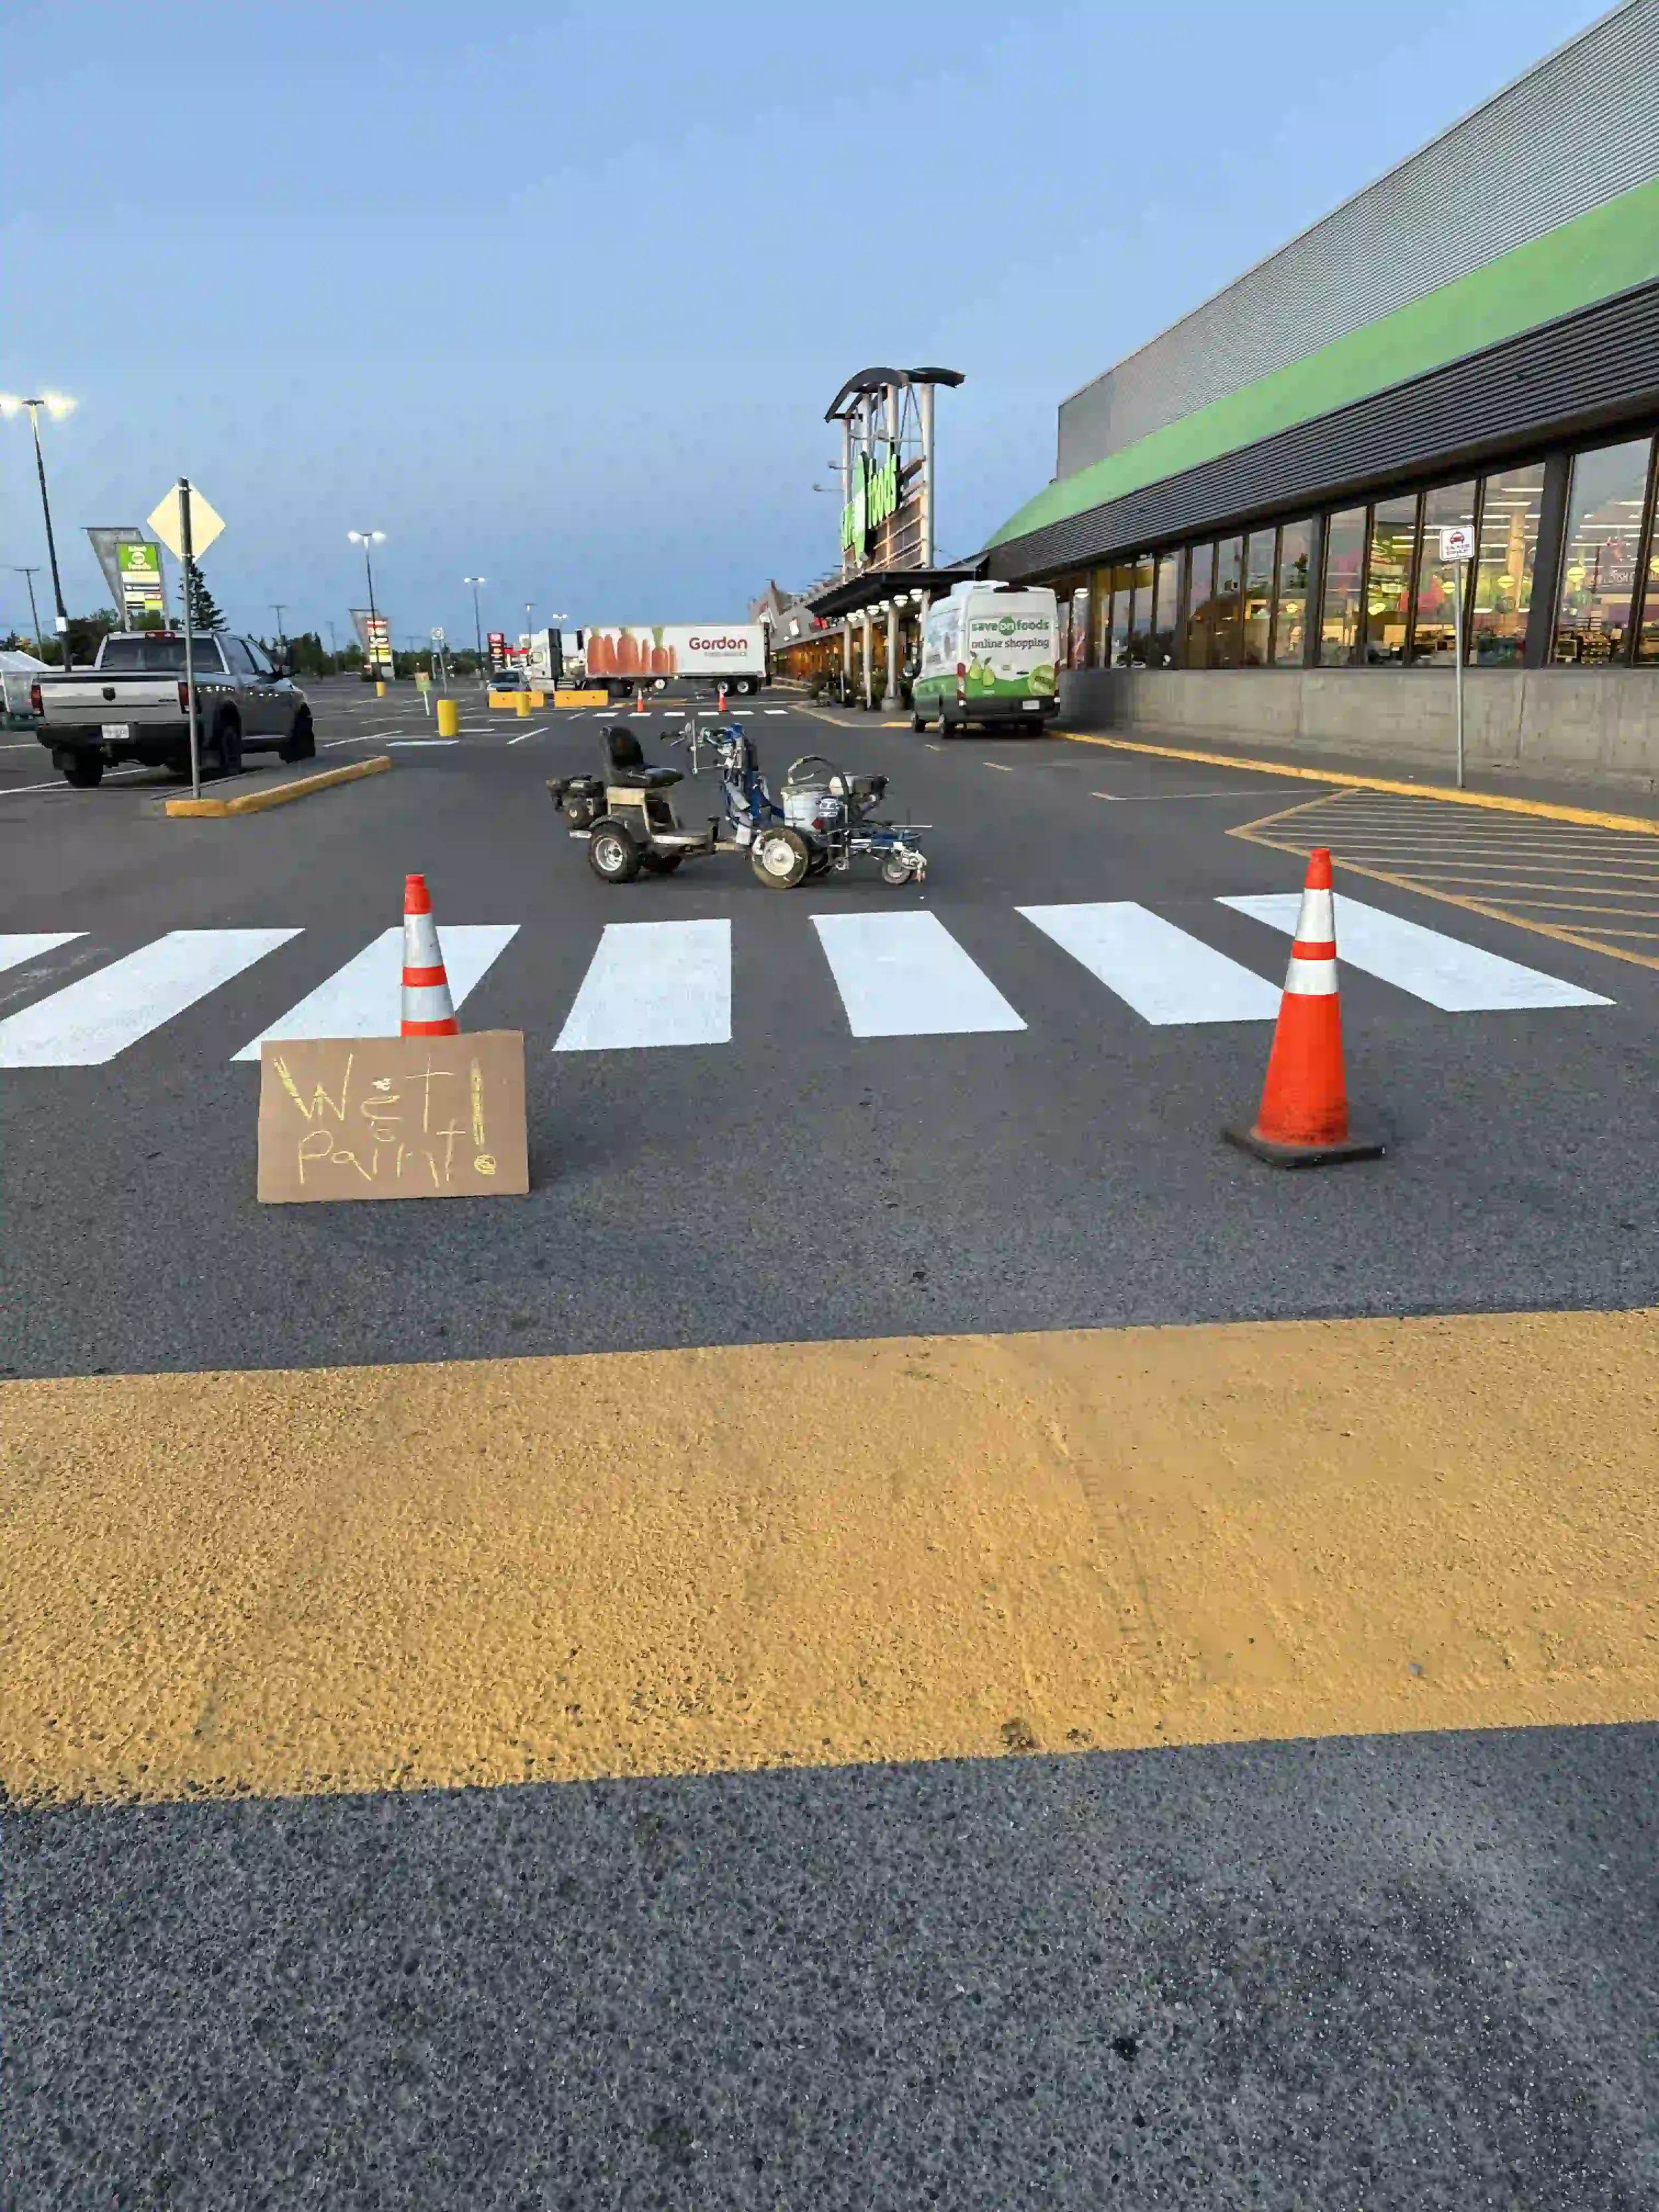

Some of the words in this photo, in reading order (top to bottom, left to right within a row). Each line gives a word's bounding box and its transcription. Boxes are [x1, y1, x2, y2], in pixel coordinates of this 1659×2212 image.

[972, 623, 997, 631] save
[1017, 619, 1050, 630] foods
[689, 636, 748, 650] Gordon
[972, 638, 1002, 648] online
[1005, 637, 1050, 650] shopping
